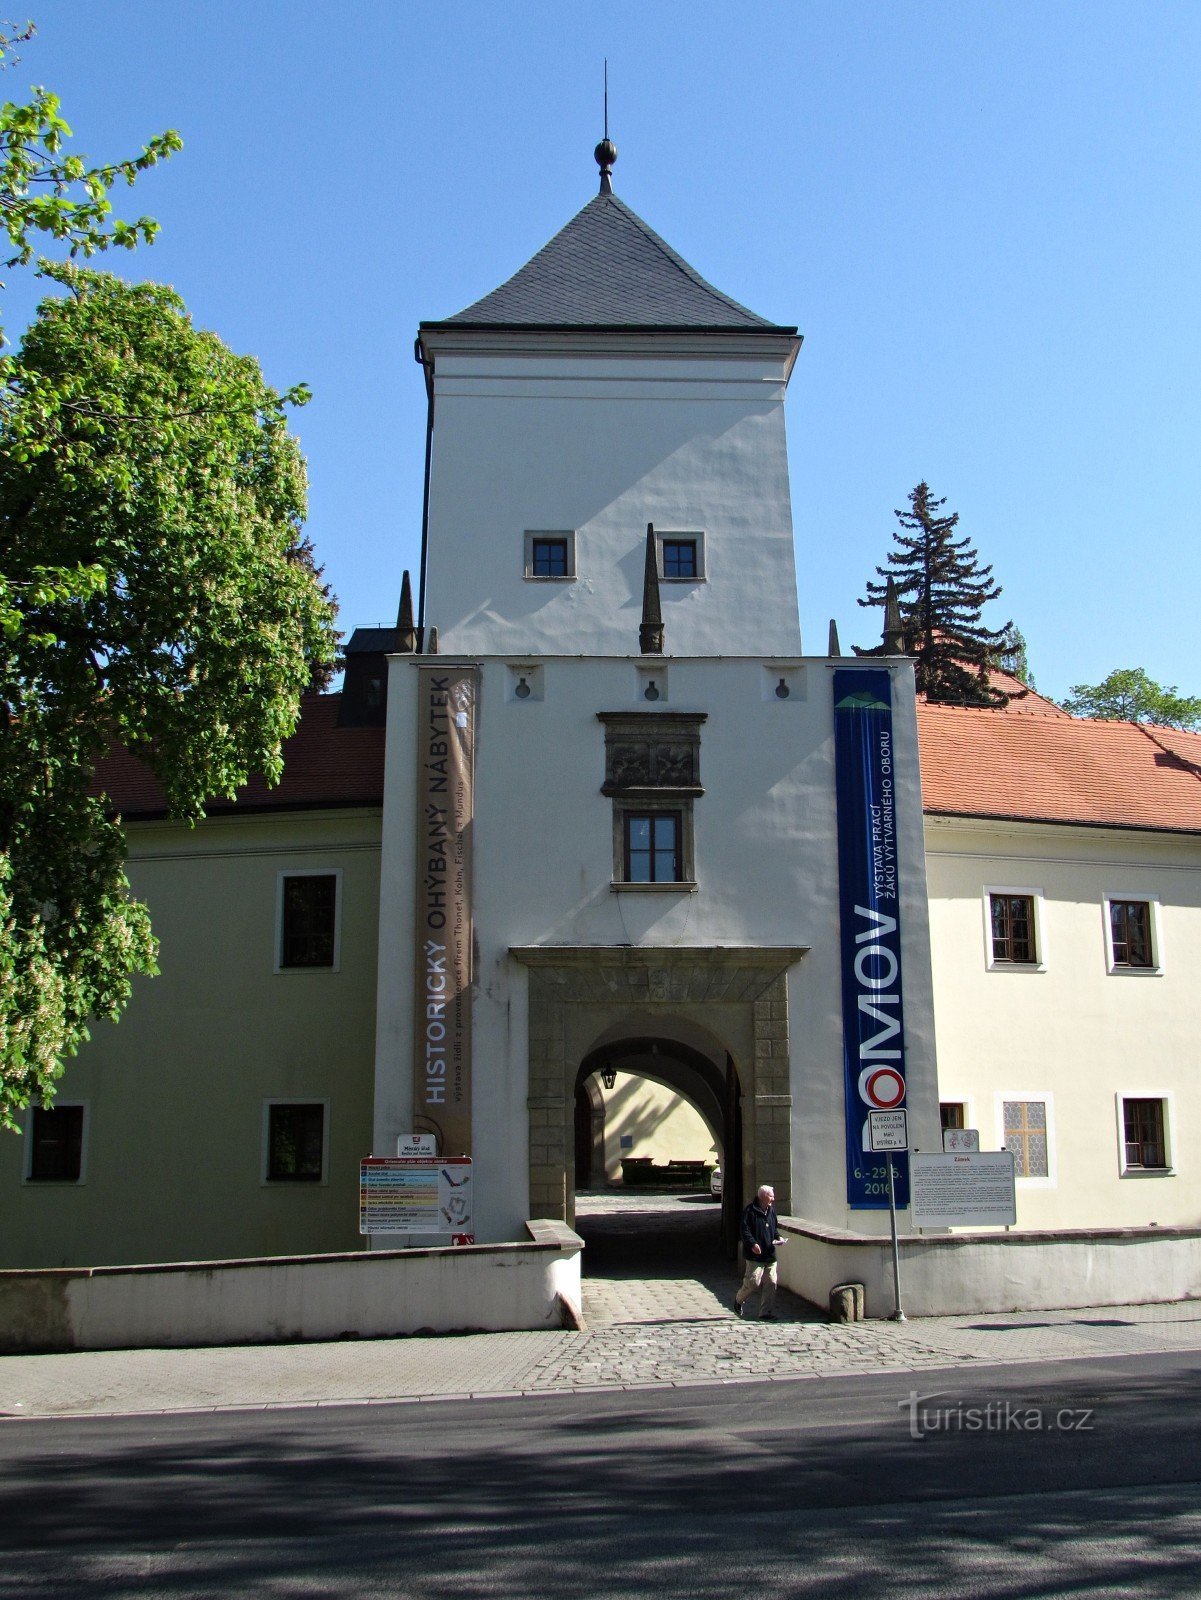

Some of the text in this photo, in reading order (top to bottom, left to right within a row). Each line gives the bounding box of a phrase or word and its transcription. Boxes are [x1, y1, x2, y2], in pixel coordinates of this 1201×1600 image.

[455, 780, 464, 819] Mundus
[880, 731, 896, 900] ŽÁKŮ VÝTVARNÉHO OBORU
[454, 831, 464, 865] Fischel
[870, 804, 884, 899] VÝSTAVA PRACÍ
[423, 677, 449, 1104] HISTORICKÝ OHÝBANÝ NÁBYTEK
[454, 867, 464, 896] Kohn,
[454, 899, 464, 937] Thonet,
[454, 940, 463, 967] firem
[456, 968, 464, 1028] provenience
[854, 904, 902, 1152] OMOV
[454, 1065, 463, 1103] výstava
